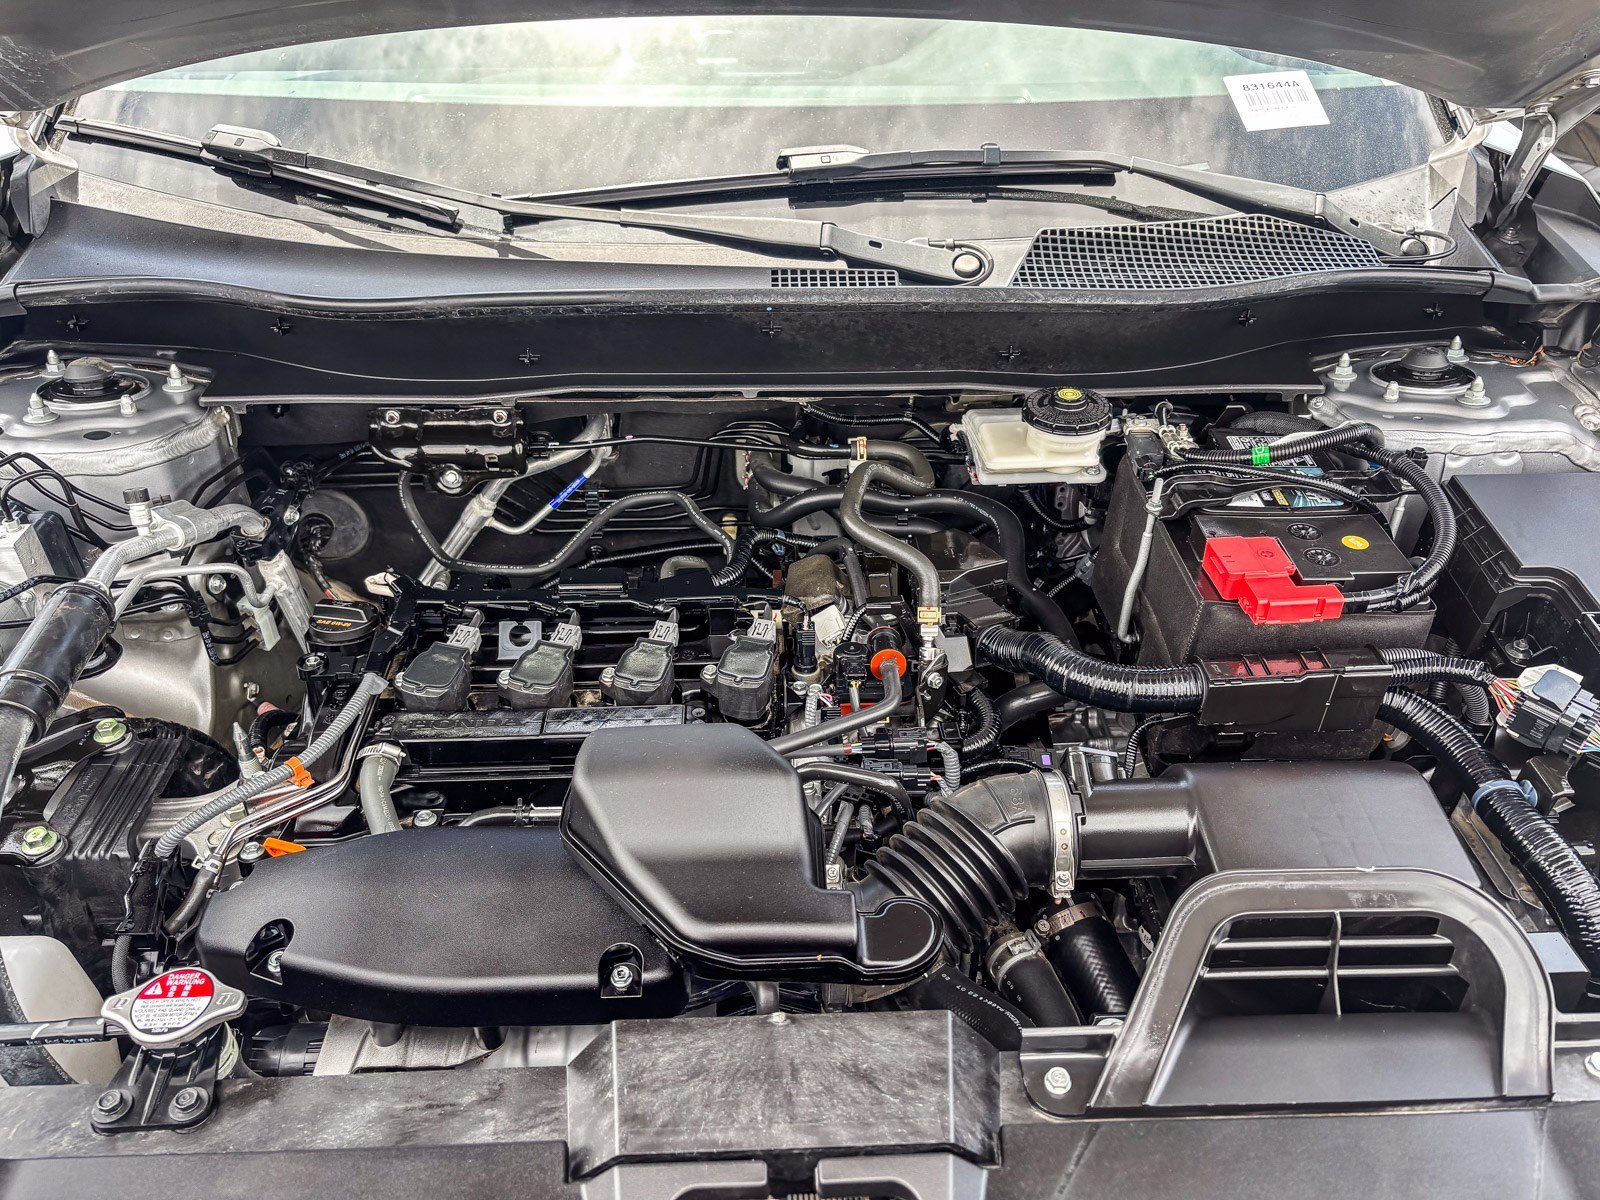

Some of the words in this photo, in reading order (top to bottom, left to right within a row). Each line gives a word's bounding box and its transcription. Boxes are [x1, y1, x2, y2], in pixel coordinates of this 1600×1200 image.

[1242, 81, 1300, 91] 831644A
[407, 718, 527, 731] HONDA
[168, 973, 202, 981] DANGER
[166, 978, 206, 986] WARNUNG
